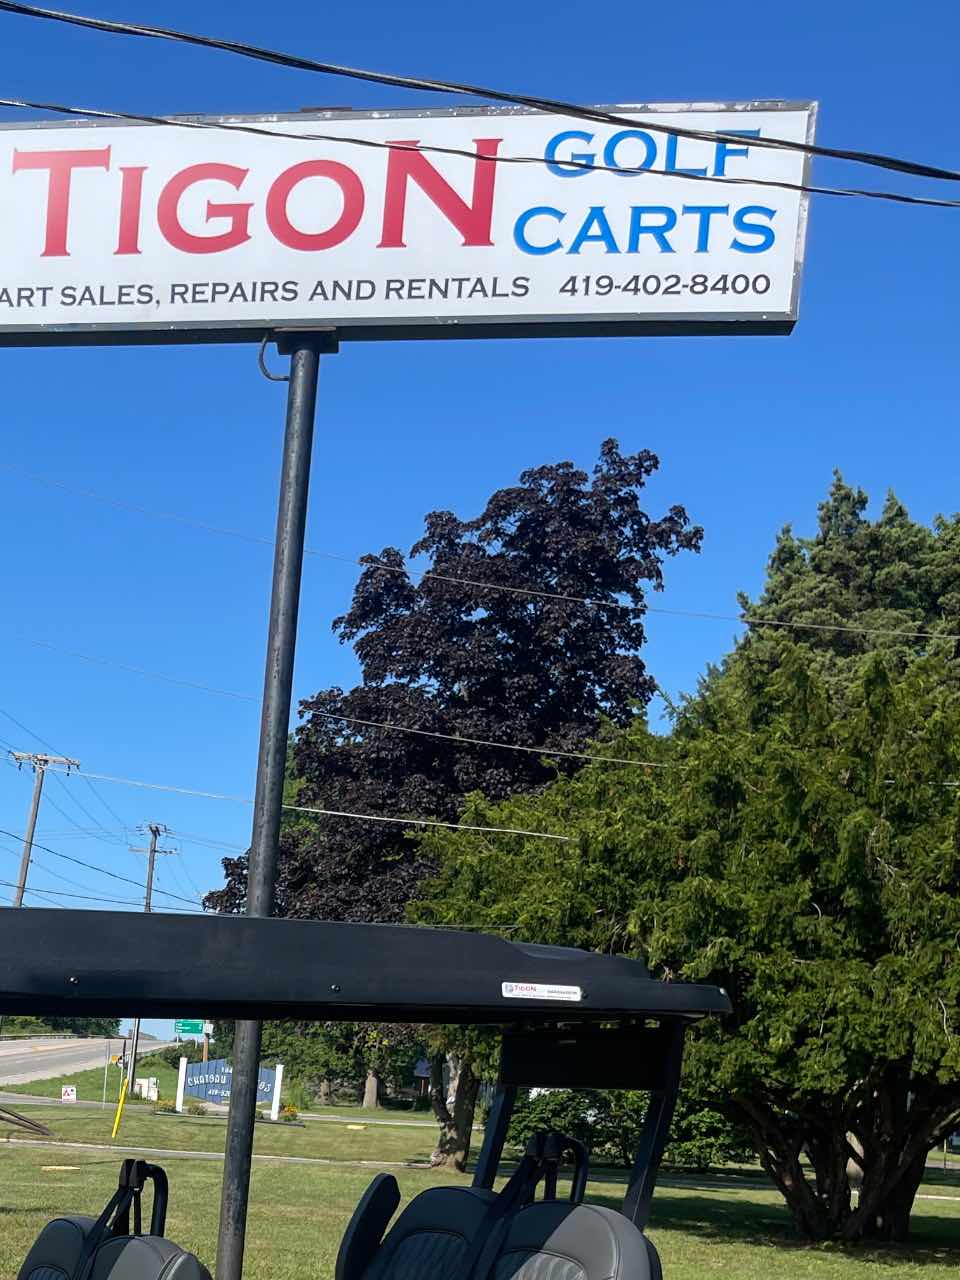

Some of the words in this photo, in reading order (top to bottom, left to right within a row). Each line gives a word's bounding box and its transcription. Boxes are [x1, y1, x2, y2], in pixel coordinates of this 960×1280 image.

[543, 128, 761, 178] GOLF
[12, 138, 503, 258] TIGON
[513, 204, 776, 255] CARTS
[59, 284, 161, 310] SALES,
[170, 280, 300, 305] REPAIRS
[308, 279, 377, 302] AND
[384, 276, 530, 300] RENTALS
[558, 273, 772, 298] 419-402-8400
